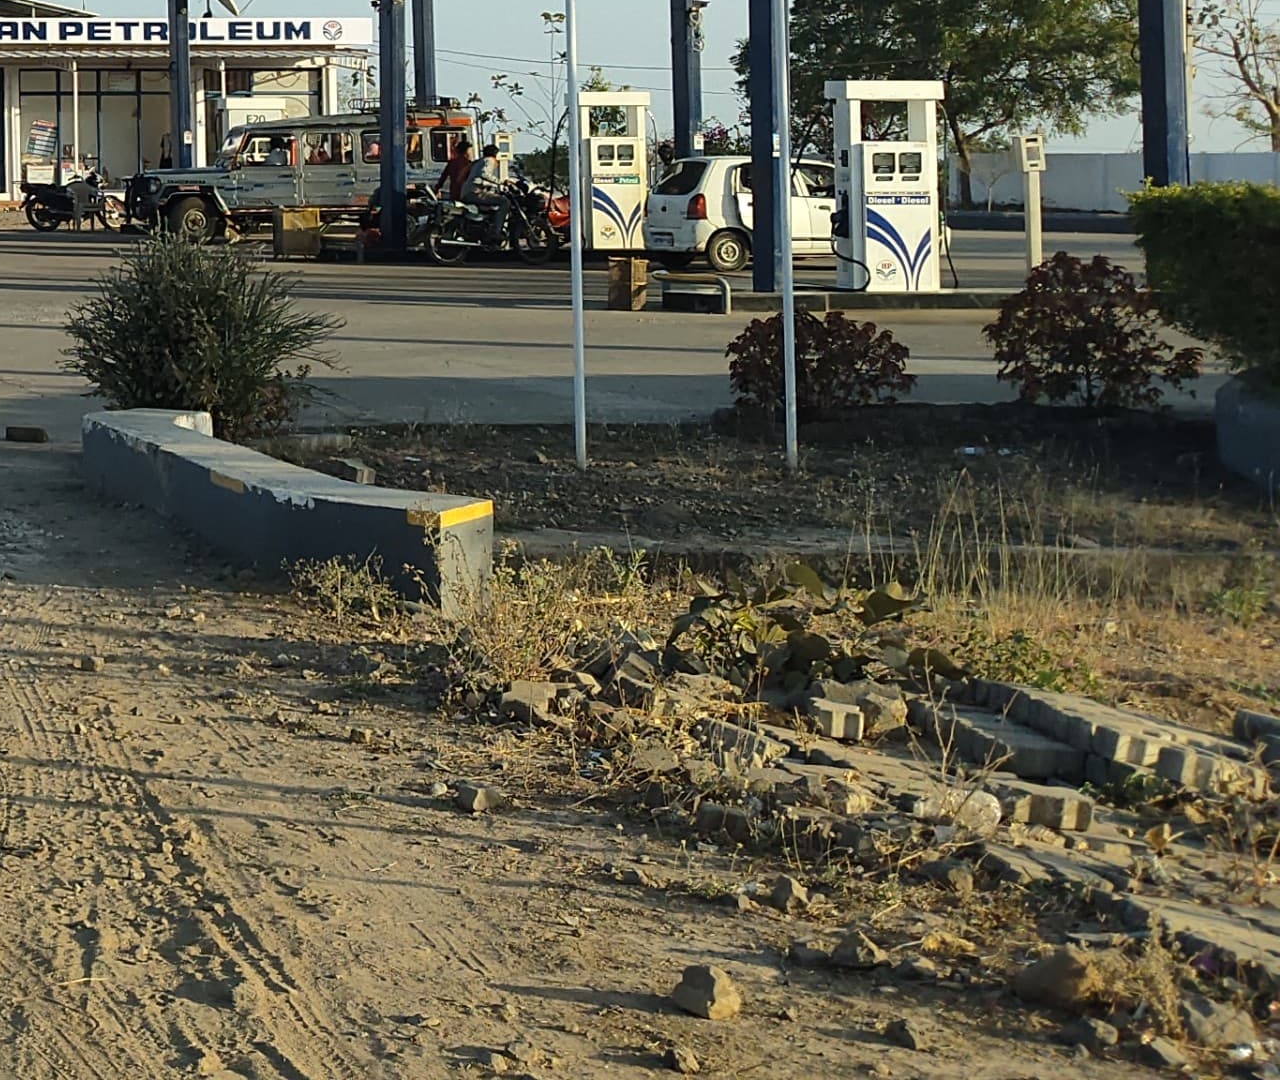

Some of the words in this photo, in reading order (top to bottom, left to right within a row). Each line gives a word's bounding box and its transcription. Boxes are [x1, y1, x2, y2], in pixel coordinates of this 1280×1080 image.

[58, 21, 311, 41] PETRLEUM
[867, 195, 896, 205] Diesel
[900, 195, 929, 205] Diesel
